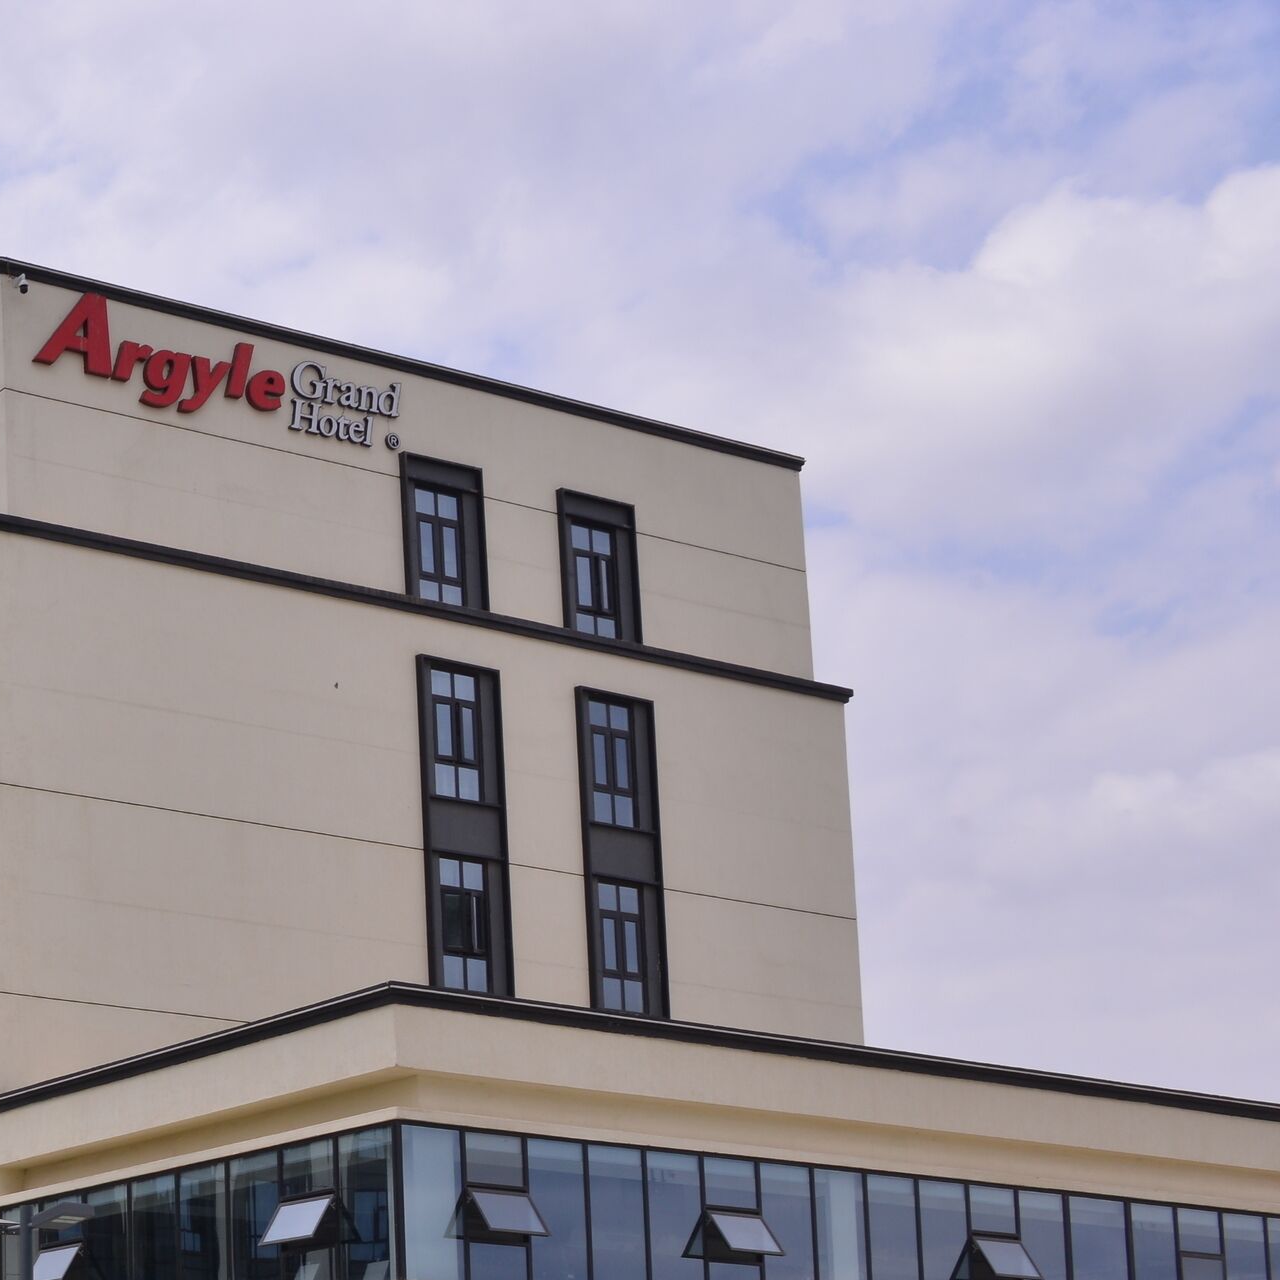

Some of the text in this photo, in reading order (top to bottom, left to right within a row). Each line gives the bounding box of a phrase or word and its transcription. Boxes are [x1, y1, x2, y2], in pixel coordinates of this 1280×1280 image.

[32, 291, 286, 413] Argyle
[291, 360, 401, 418] Grand
[288, 398, 374, 448] Hotel
